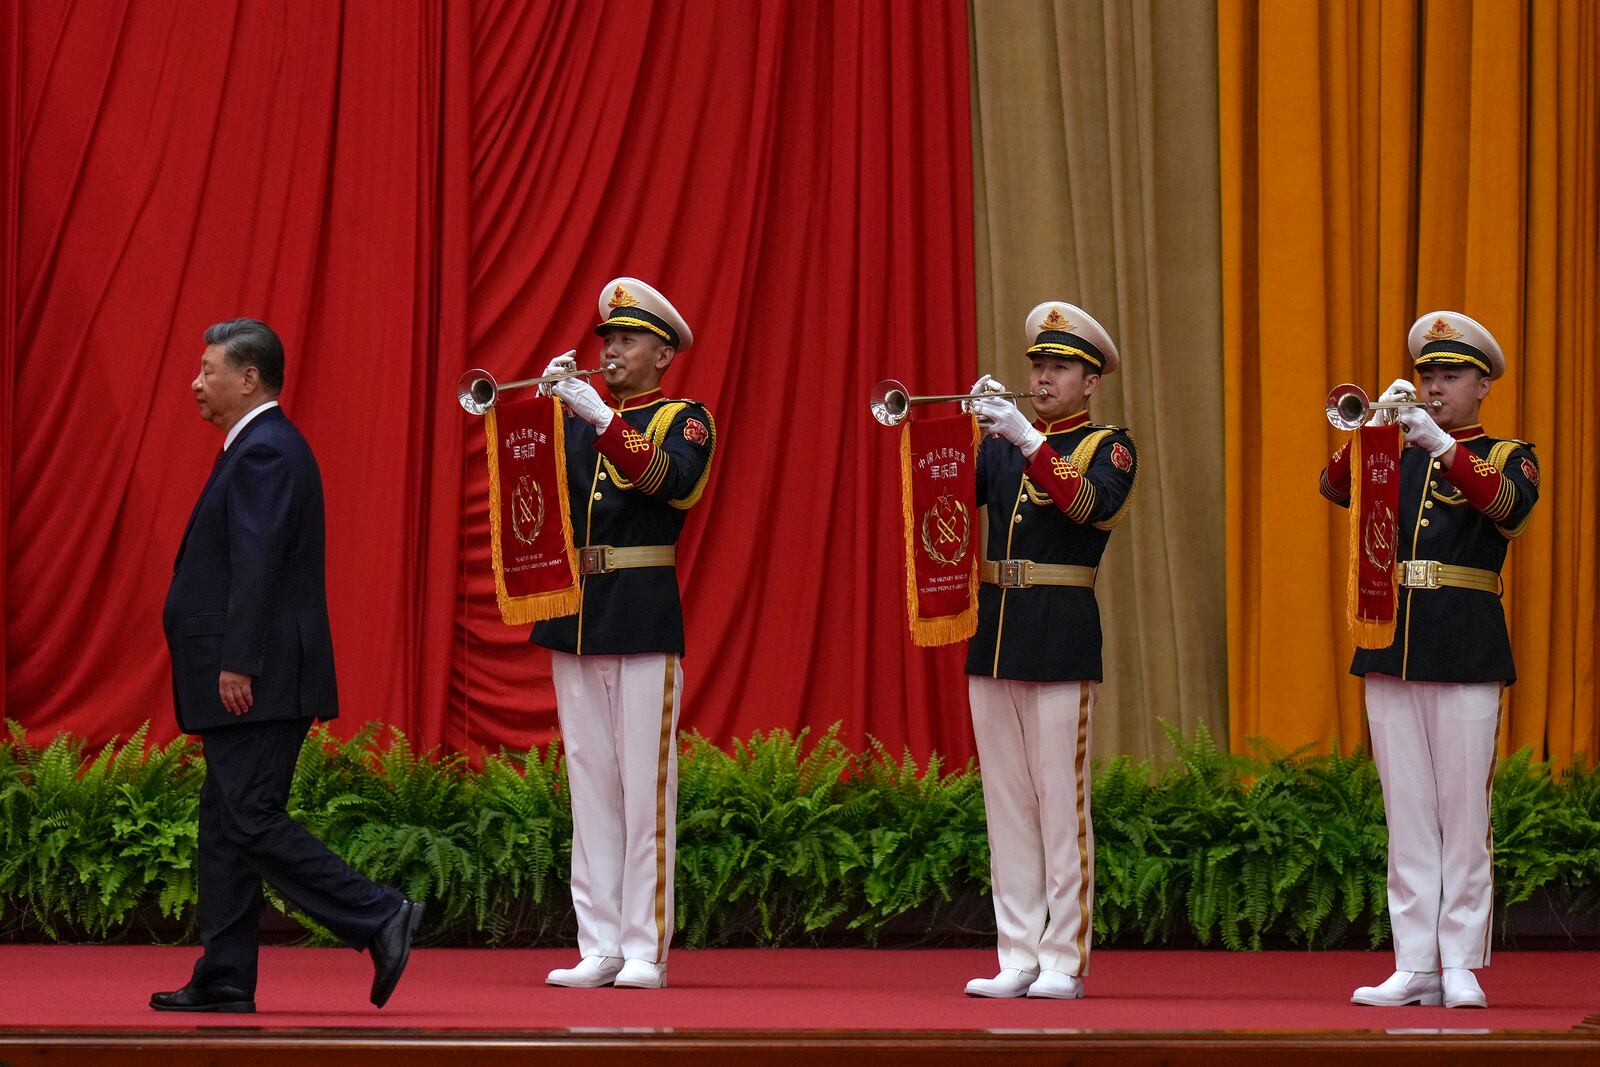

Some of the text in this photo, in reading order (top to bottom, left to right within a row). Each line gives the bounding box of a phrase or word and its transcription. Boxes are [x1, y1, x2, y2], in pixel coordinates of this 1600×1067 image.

[513, 443, 535, 461] 军乐团
[918, 447, 966, 469] 中国人民解放军
[930, 462, 958, 480] 军乐团
